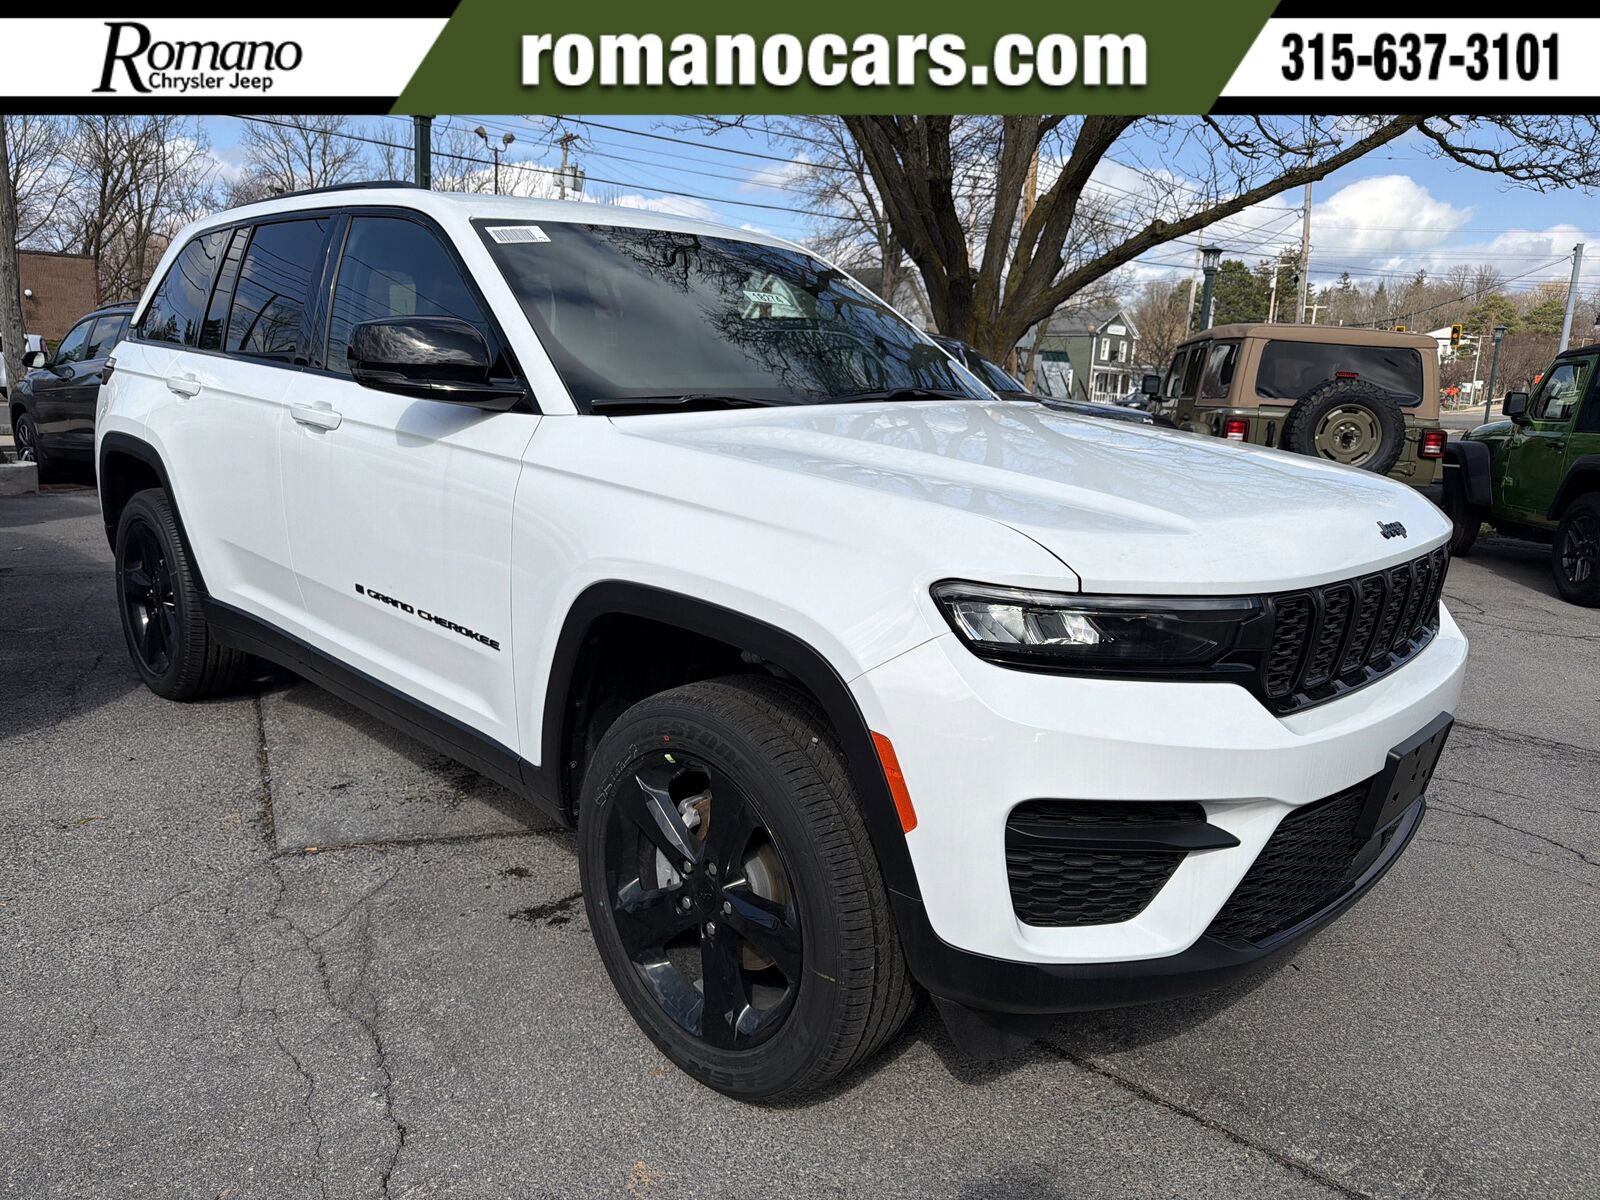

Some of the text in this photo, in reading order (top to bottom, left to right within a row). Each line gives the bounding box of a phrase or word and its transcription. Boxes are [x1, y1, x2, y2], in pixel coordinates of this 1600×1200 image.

[1376, 520, 1408, 540] Jeep
[367, 589, 501, 652] GRAND CHEROKEE
